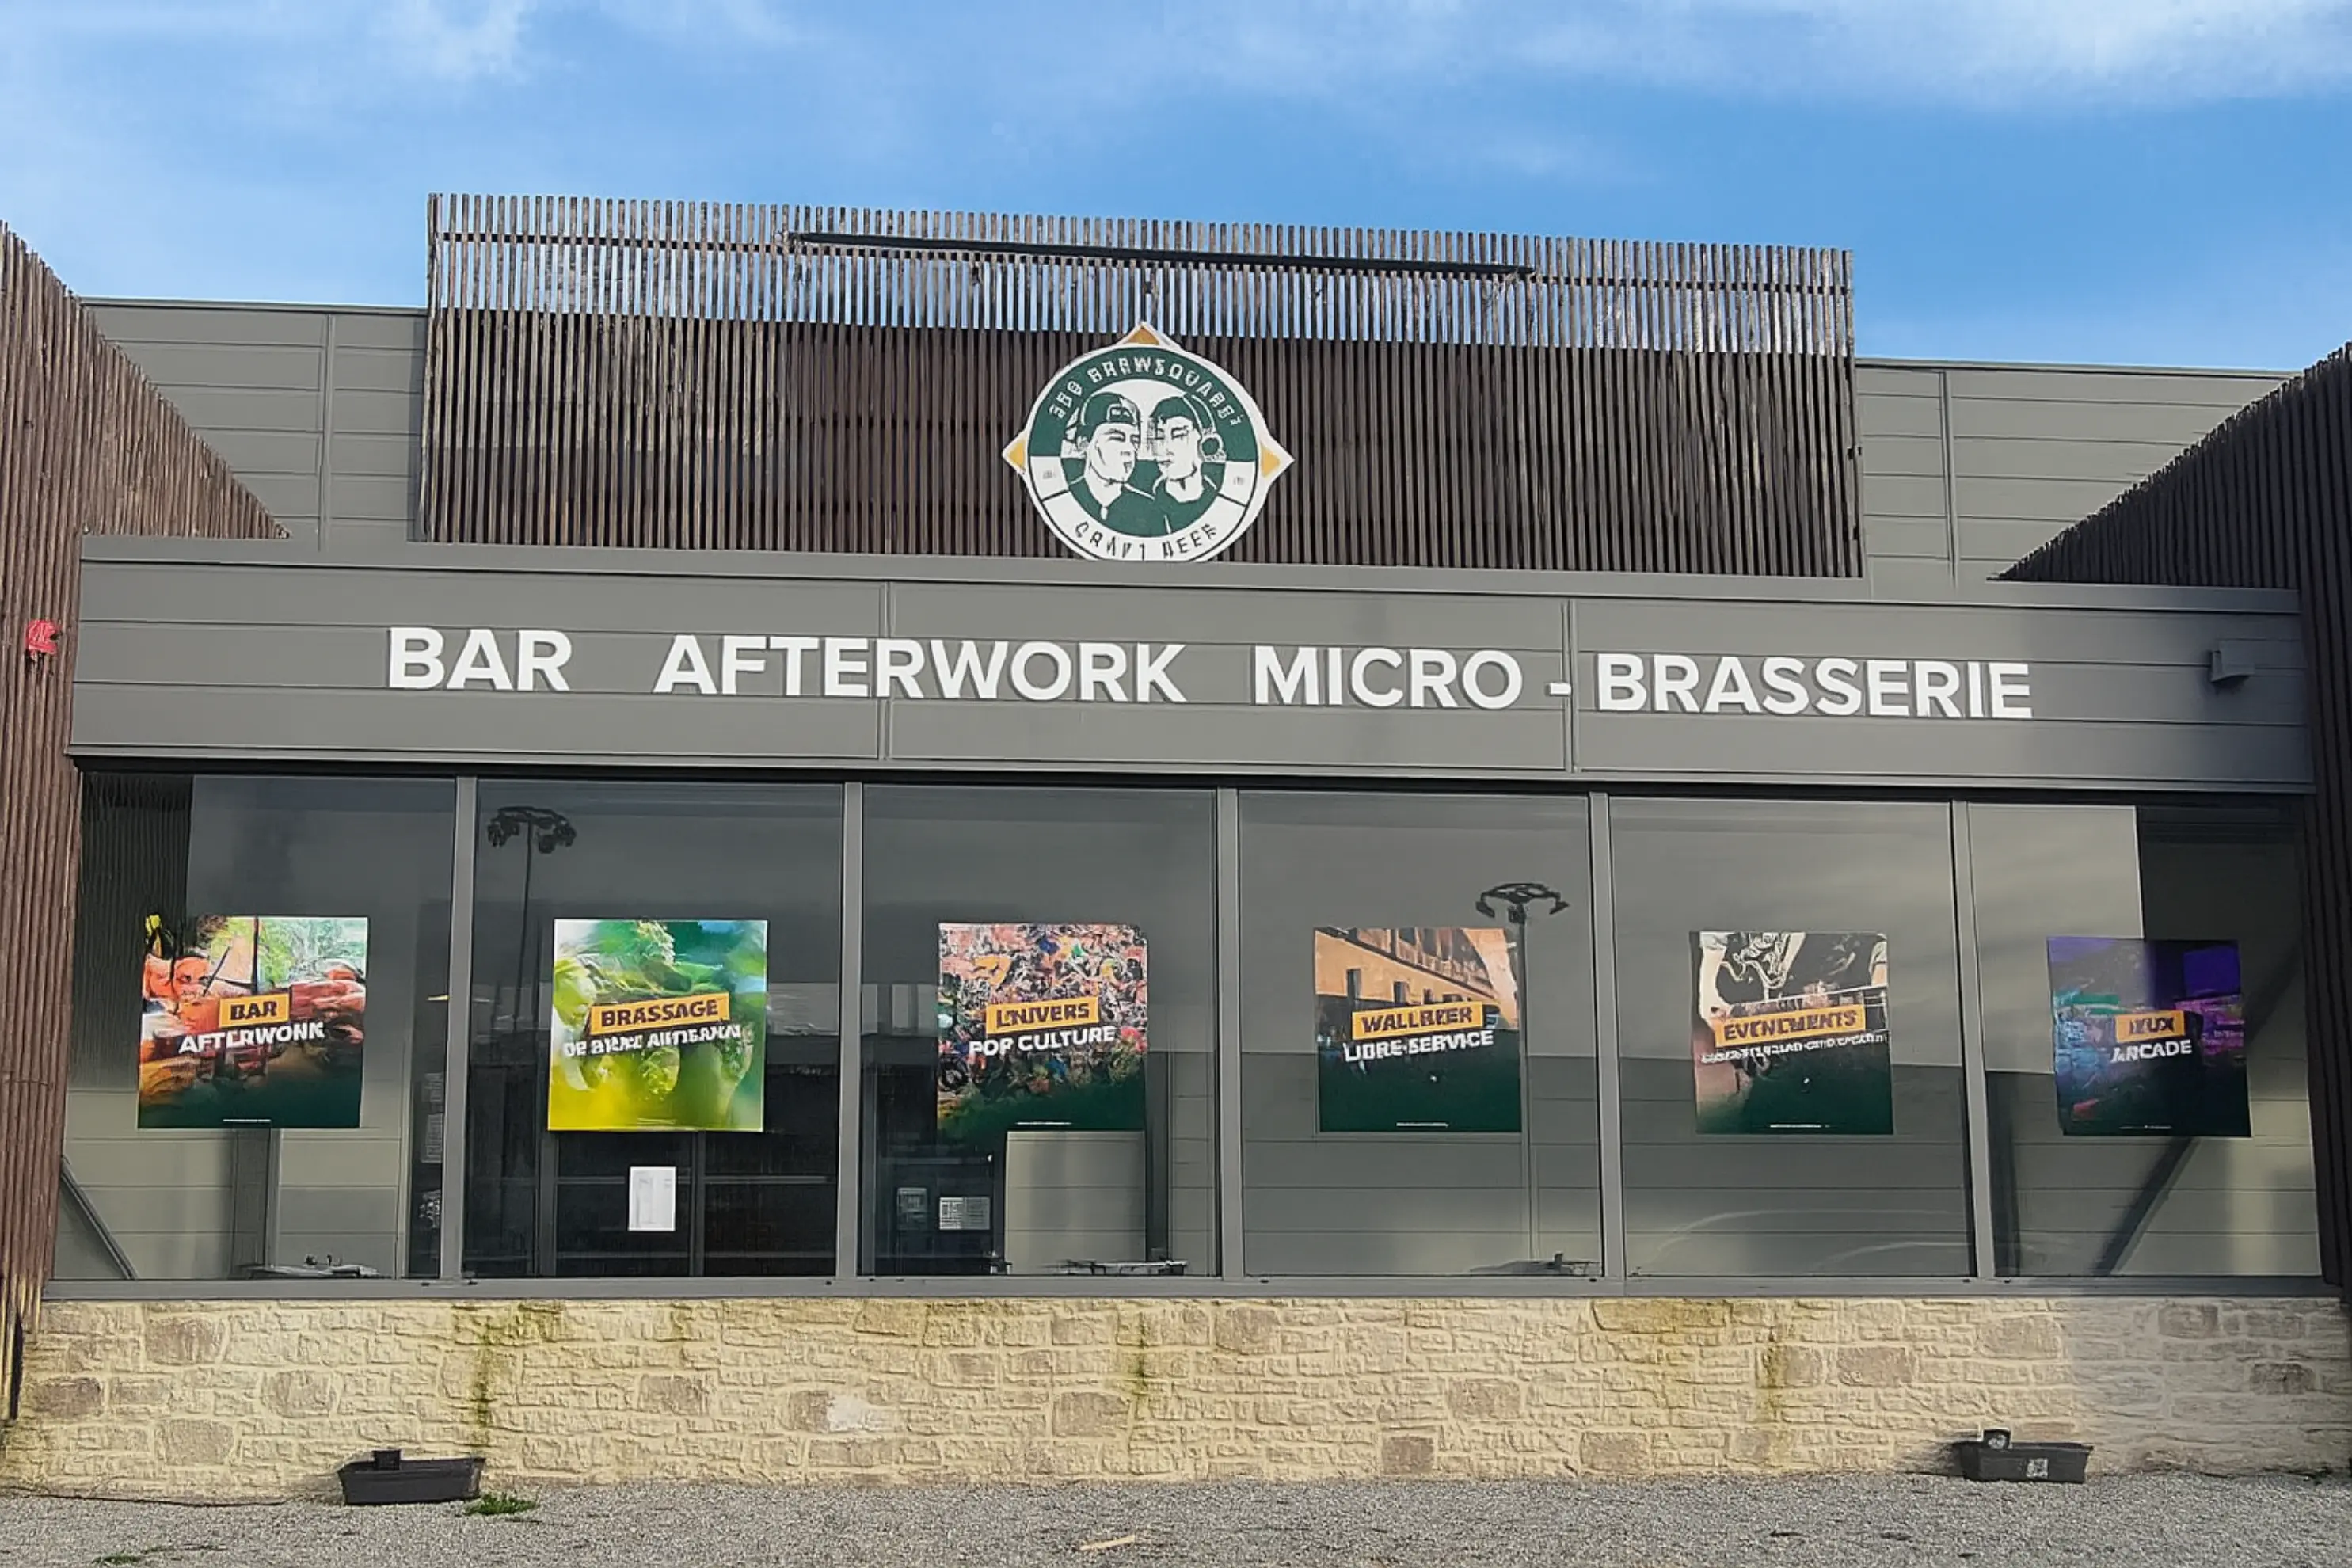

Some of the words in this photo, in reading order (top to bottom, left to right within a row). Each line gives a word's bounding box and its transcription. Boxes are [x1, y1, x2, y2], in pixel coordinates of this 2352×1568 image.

[387, 626, 573, 691] BAR
[653, 634, 1187, 702] AFTERWORK
[1254, 645, 1523, 710] MICRO
[1597, 653, 2034, 719] BRASSERIE
[230, 1000, 277, 1020] BAR
[600, 999, 718, 1027] BRASSAGE
[2129, 1017, 2175, 1035] UX
[969, 1037, 1014, 1056] POP
[1018, 1026, 1117, 1052] CULTURE
